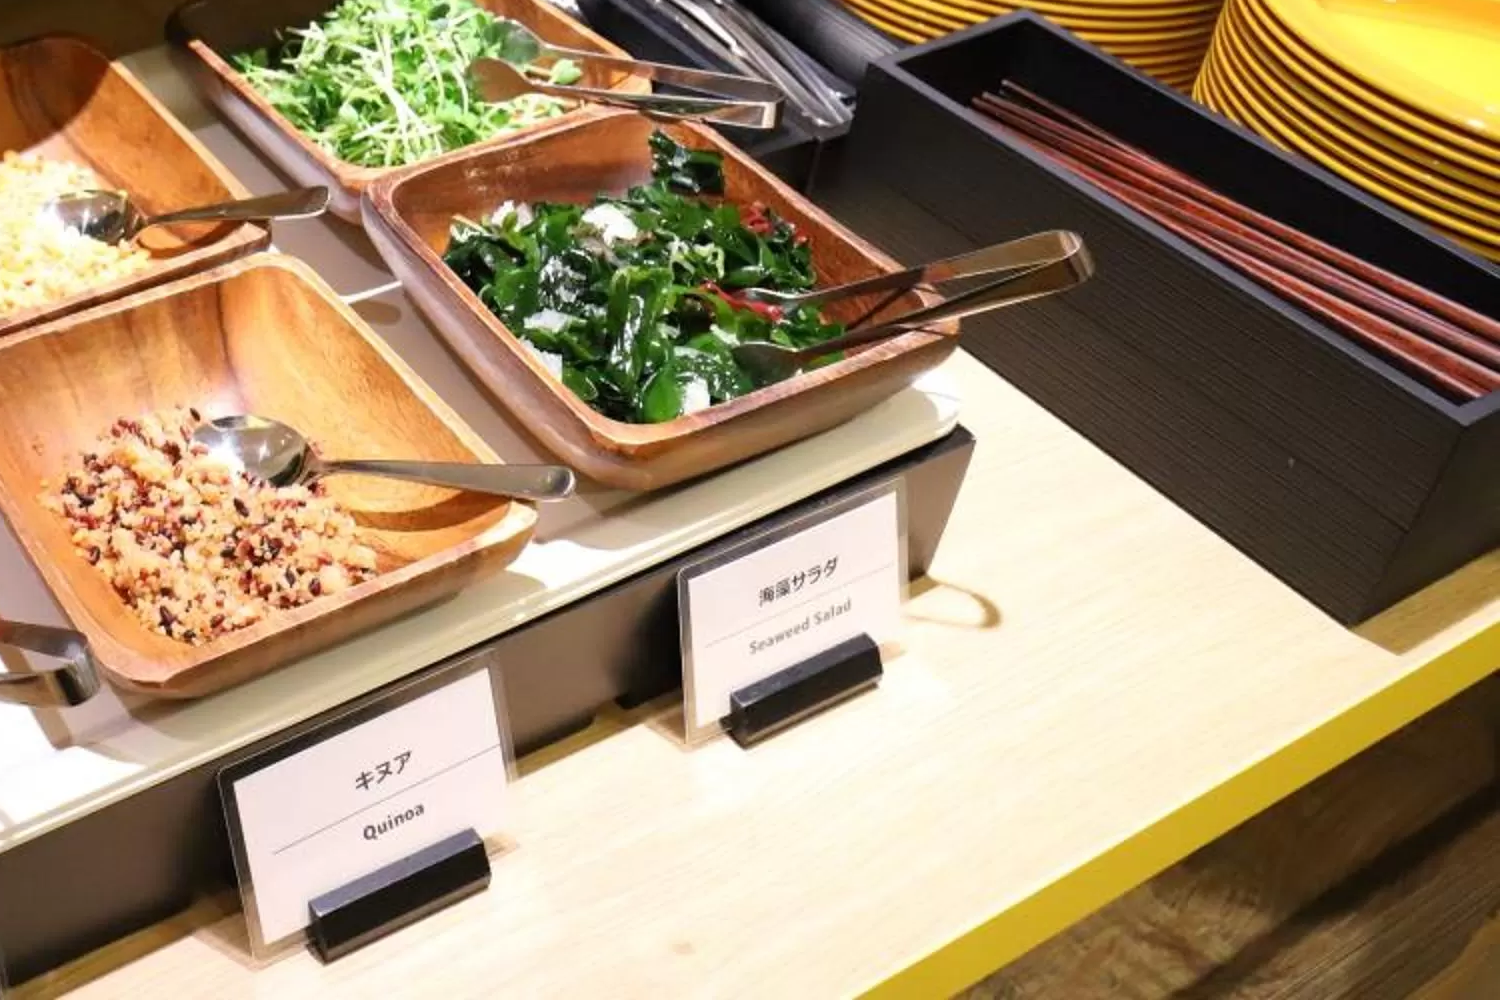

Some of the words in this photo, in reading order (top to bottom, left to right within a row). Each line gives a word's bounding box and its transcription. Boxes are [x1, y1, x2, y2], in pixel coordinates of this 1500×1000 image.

[758, 556, 839, 608] 海藻サラダ
[749, 616, 811, 655] Seaweed
[814, 596, 853, 625] Salad
[354, 750, 412, 791] キヌア
[362, 803, 426, 841] Quinoa
